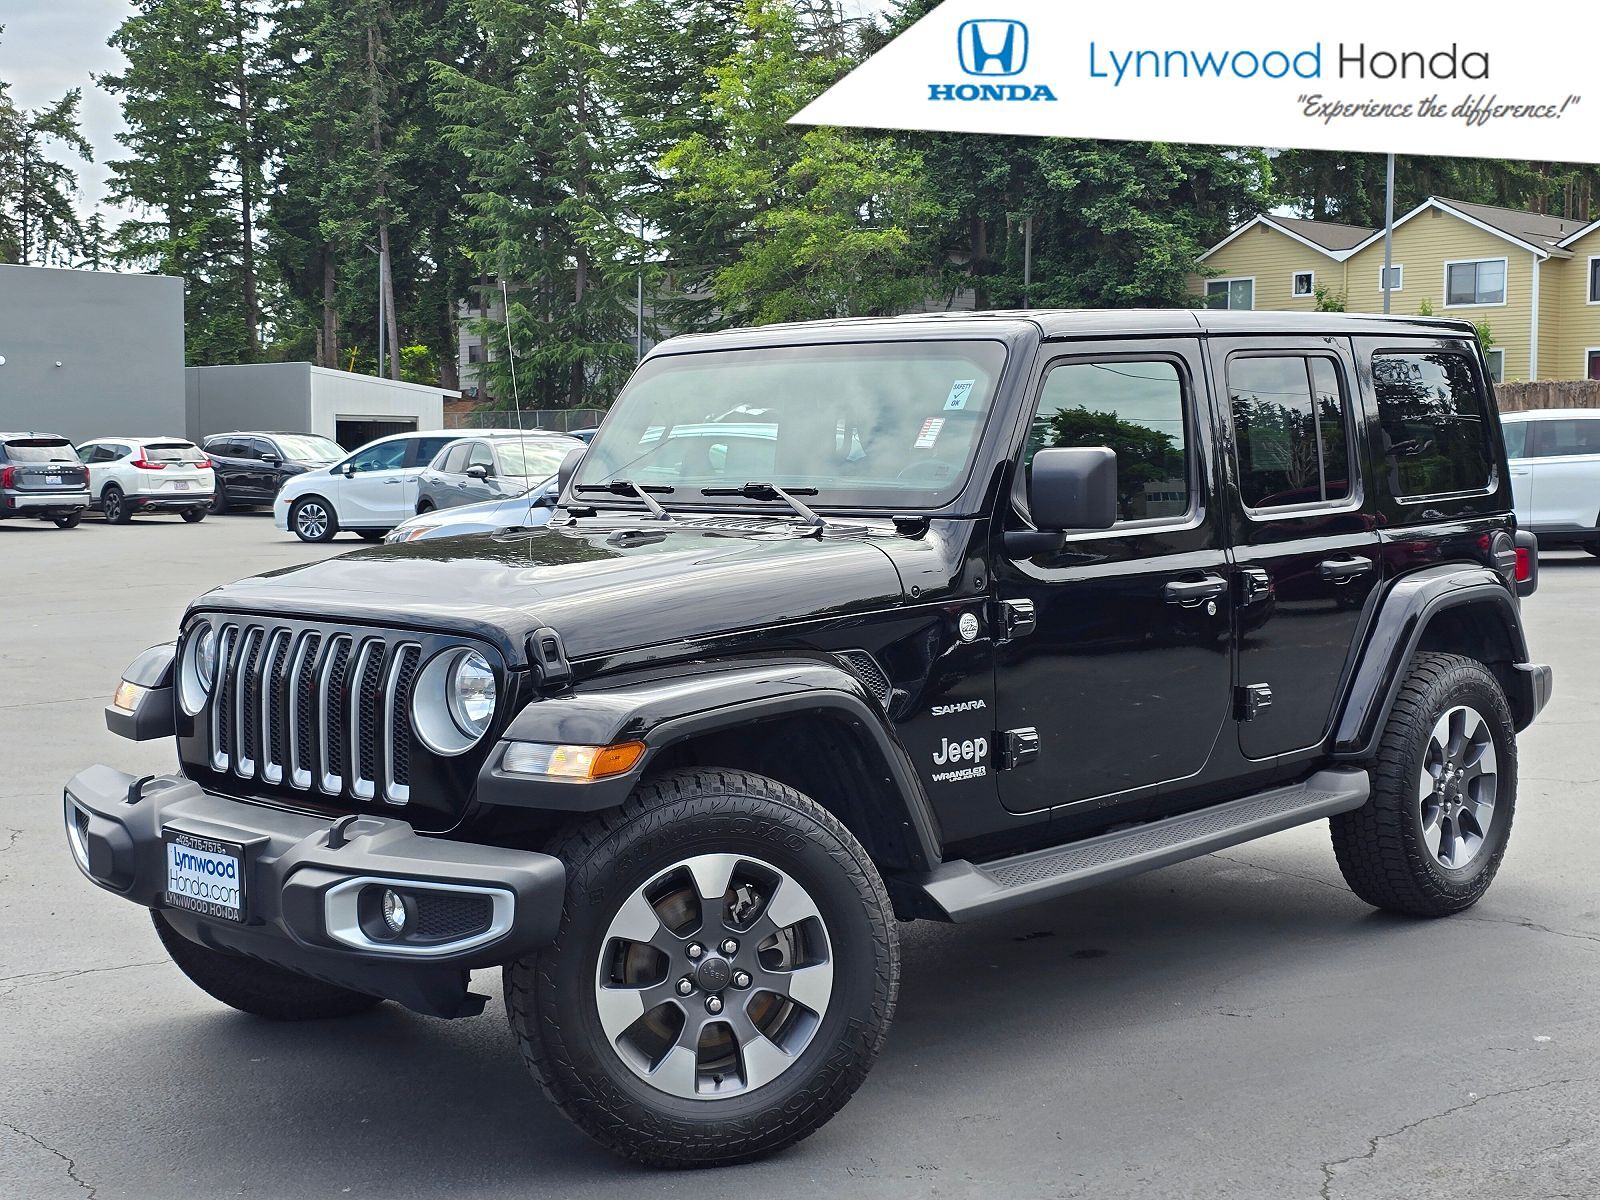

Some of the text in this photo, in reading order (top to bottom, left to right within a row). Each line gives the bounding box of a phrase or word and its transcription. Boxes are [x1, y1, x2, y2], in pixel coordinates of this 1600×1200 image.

[931, 700, 987, 716] SAHARA
[932, 737, 988, 765] Jeep
[932, 766, 986, 782] WRANGLER
[178, 834, 222, 854] 425-775-7575
[173, 846, 236, 879] Lynnwood
[169, 868, 240, 904] Honda.com
[165, 891, 240, 922] LYNNWOOD HONDA
